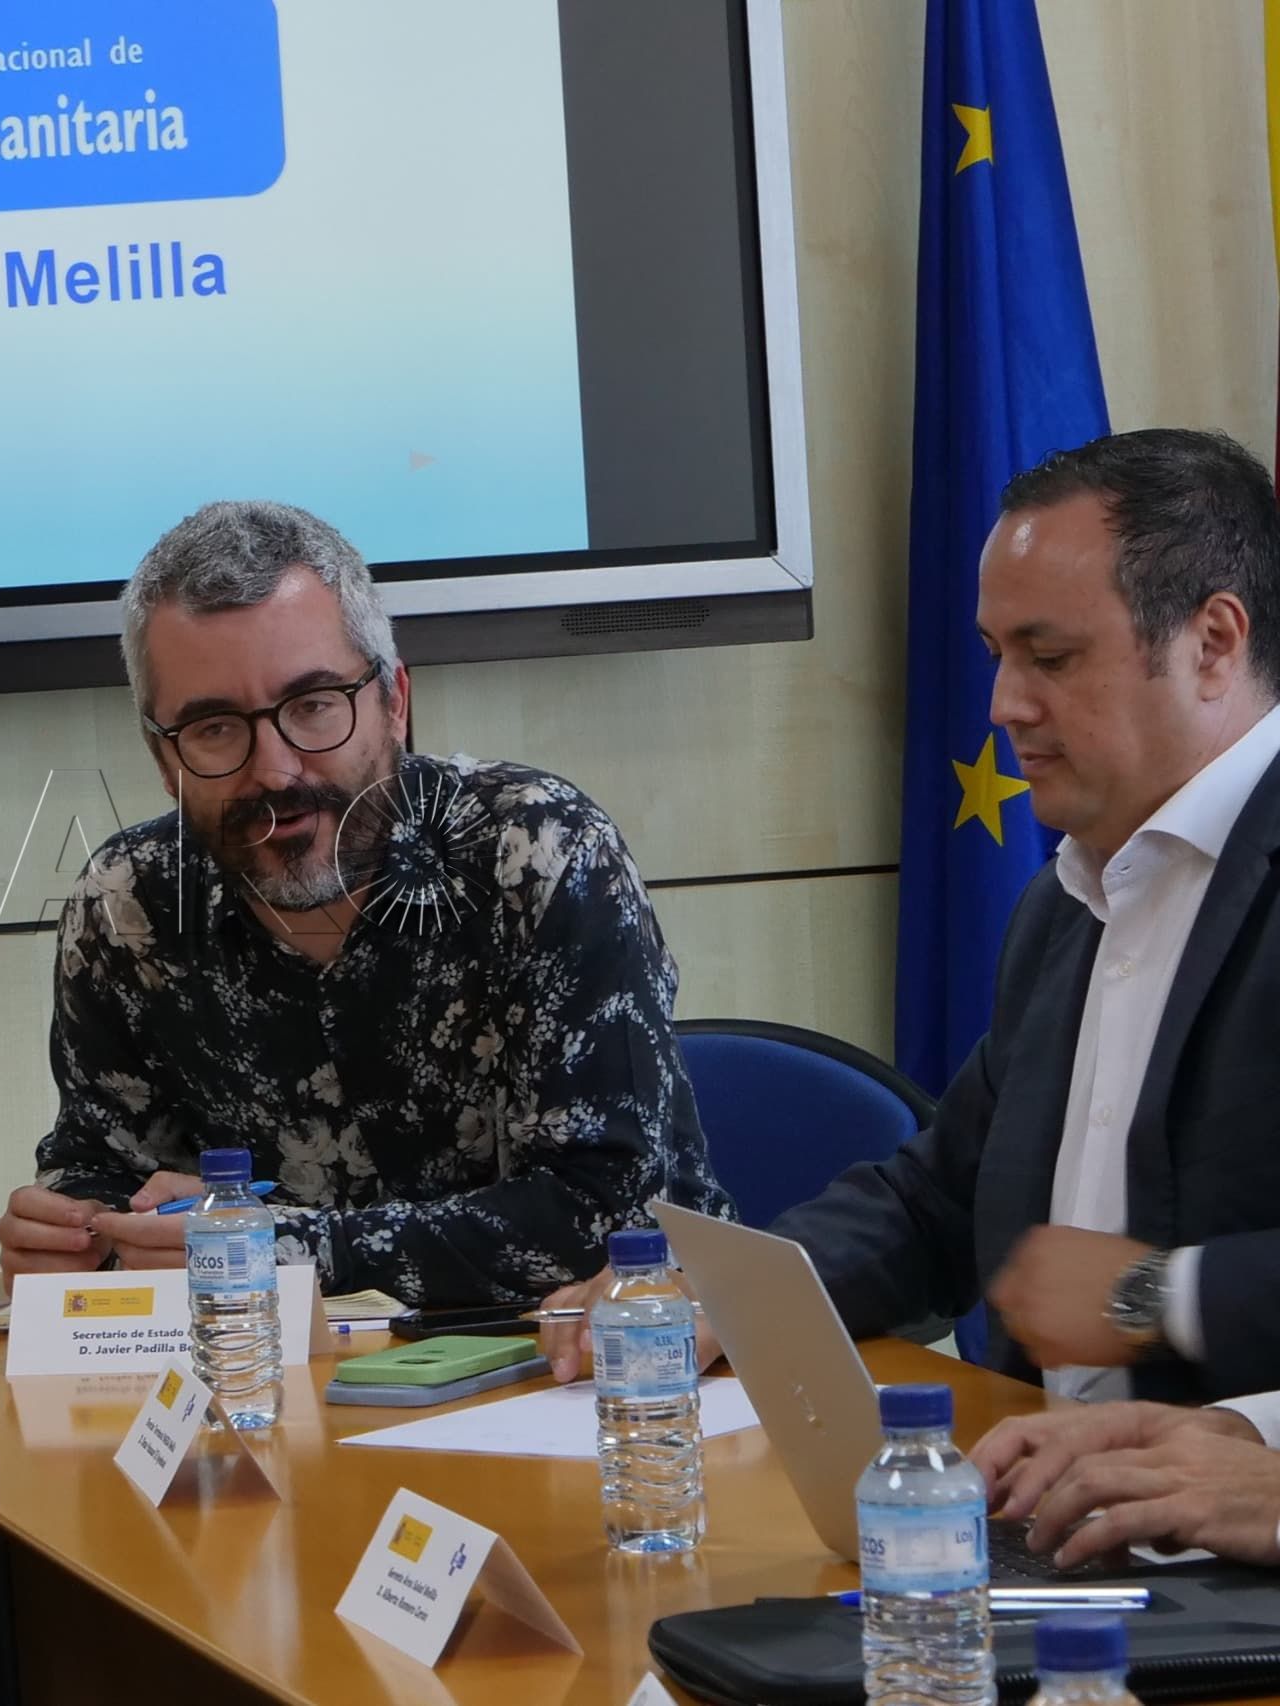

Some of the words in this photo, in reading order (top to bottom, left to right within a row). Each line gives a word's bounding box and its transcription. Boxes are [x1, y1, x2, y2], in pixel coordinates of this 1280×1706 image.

[109, 36, 144, 66] de
[4, 241, 227, 308] Melilla
[72, 1329, 128, 1340] Secretario
[131, 1329, 145, 1338] de
[147, 1328, 185, 1338] Estado
[80, 1346, 92, 1355] D.
[95, 1345, 132, 1355] Javier
[135, 1344, 176, 1353] Padilla
